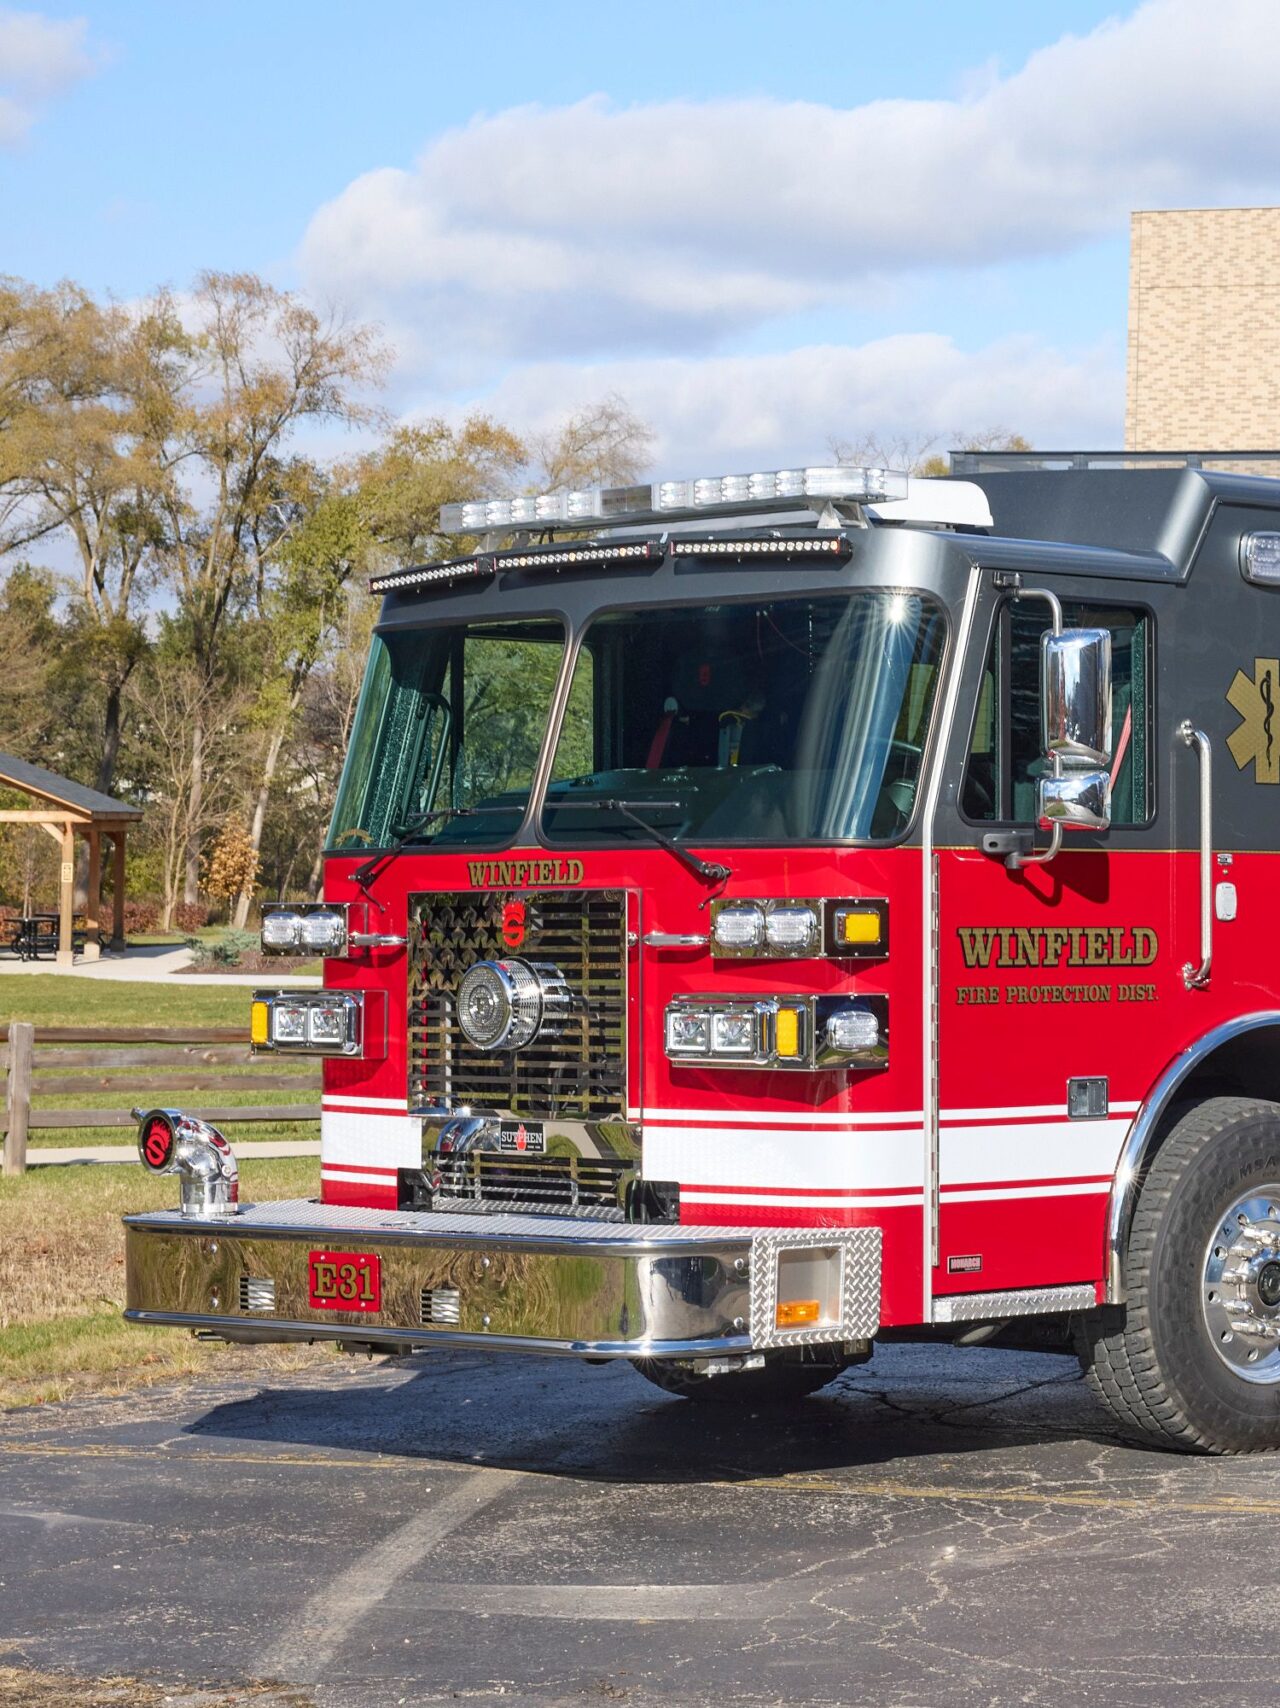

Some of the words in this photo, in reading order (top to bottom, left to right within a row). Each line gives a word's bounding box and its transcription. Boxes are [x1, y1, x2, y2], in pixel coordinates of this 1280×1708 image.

[467, 859, 585, 887] WINFIELD
[956, 926, 1159, 968] WINFIELD
[956, 986, 1000, 1004] FIRE
[1006, 985, 1112, 1003] PROTECTION
[1117, 984, 1160, 1001] DIST.
[312, 1262, 375, 1301] E31
